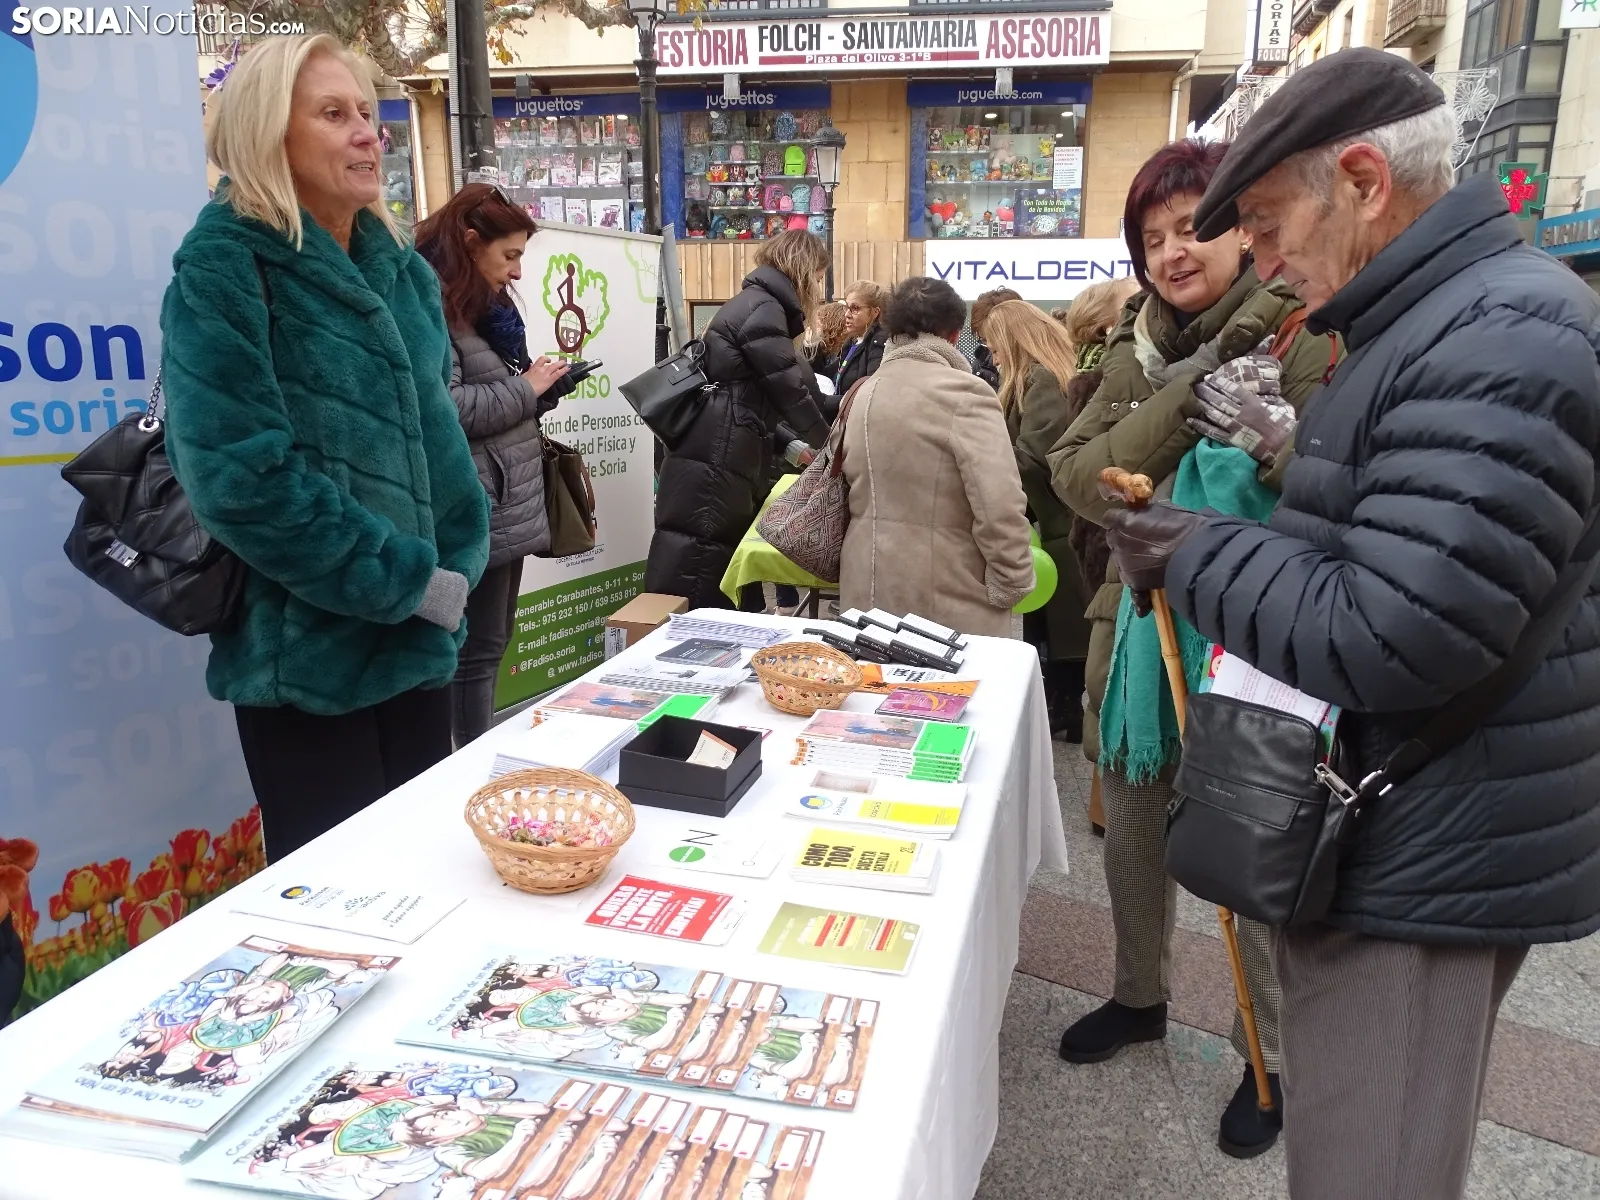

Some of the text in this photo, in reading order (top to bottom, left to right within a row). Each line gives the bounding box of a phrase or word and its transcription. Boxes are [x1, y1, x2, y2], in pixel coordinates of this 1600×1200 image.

[1268, 0, 1284, 45] ORIAS
[758, 23, 821, 53] FOLCH
[843, 19, 978, 51] SANTAMARIA
[985, 16, 1102, 60] ASESORIA
[653, 28, 749, 68] ESTORIA
[805, 54, 838, 64] Plaza
[841, 53, 860, 64] del
[864, 52, 895, 63] Olivo
[1258, 48, 1288, 61] FOLCH
[515, 96, 581, 115] juguettos
[931, 259, 1133, 280] VITALDENT
[541, 416, 562, 436] ión
[564, 415, 579, 433] de
[581, 413, 632, 431] Personas
[566, 435, 636, 456] idad Física y
[599, 457, 627, 477] Soria
[514, 595, 555, 619] Venerable
[556, 584, 604, 605] Carabantes,
[605, 577, 621, 590] 9-11
[518, 618, 541, 634] Tels.:
[542, 611, 557, 626] 975
[558, 606, 573, 621] 232
[575, 601, 589, 615] 150
[595, 595, 608, 608] 639
[610, 591, 623, 603] 553
[624, 587, 637, 599] 812
[517, 634, 548, 654] E-mail:
[519, 644, 576, 672] @Fadiso.soria
[801, 843, 830, 867] COMO
